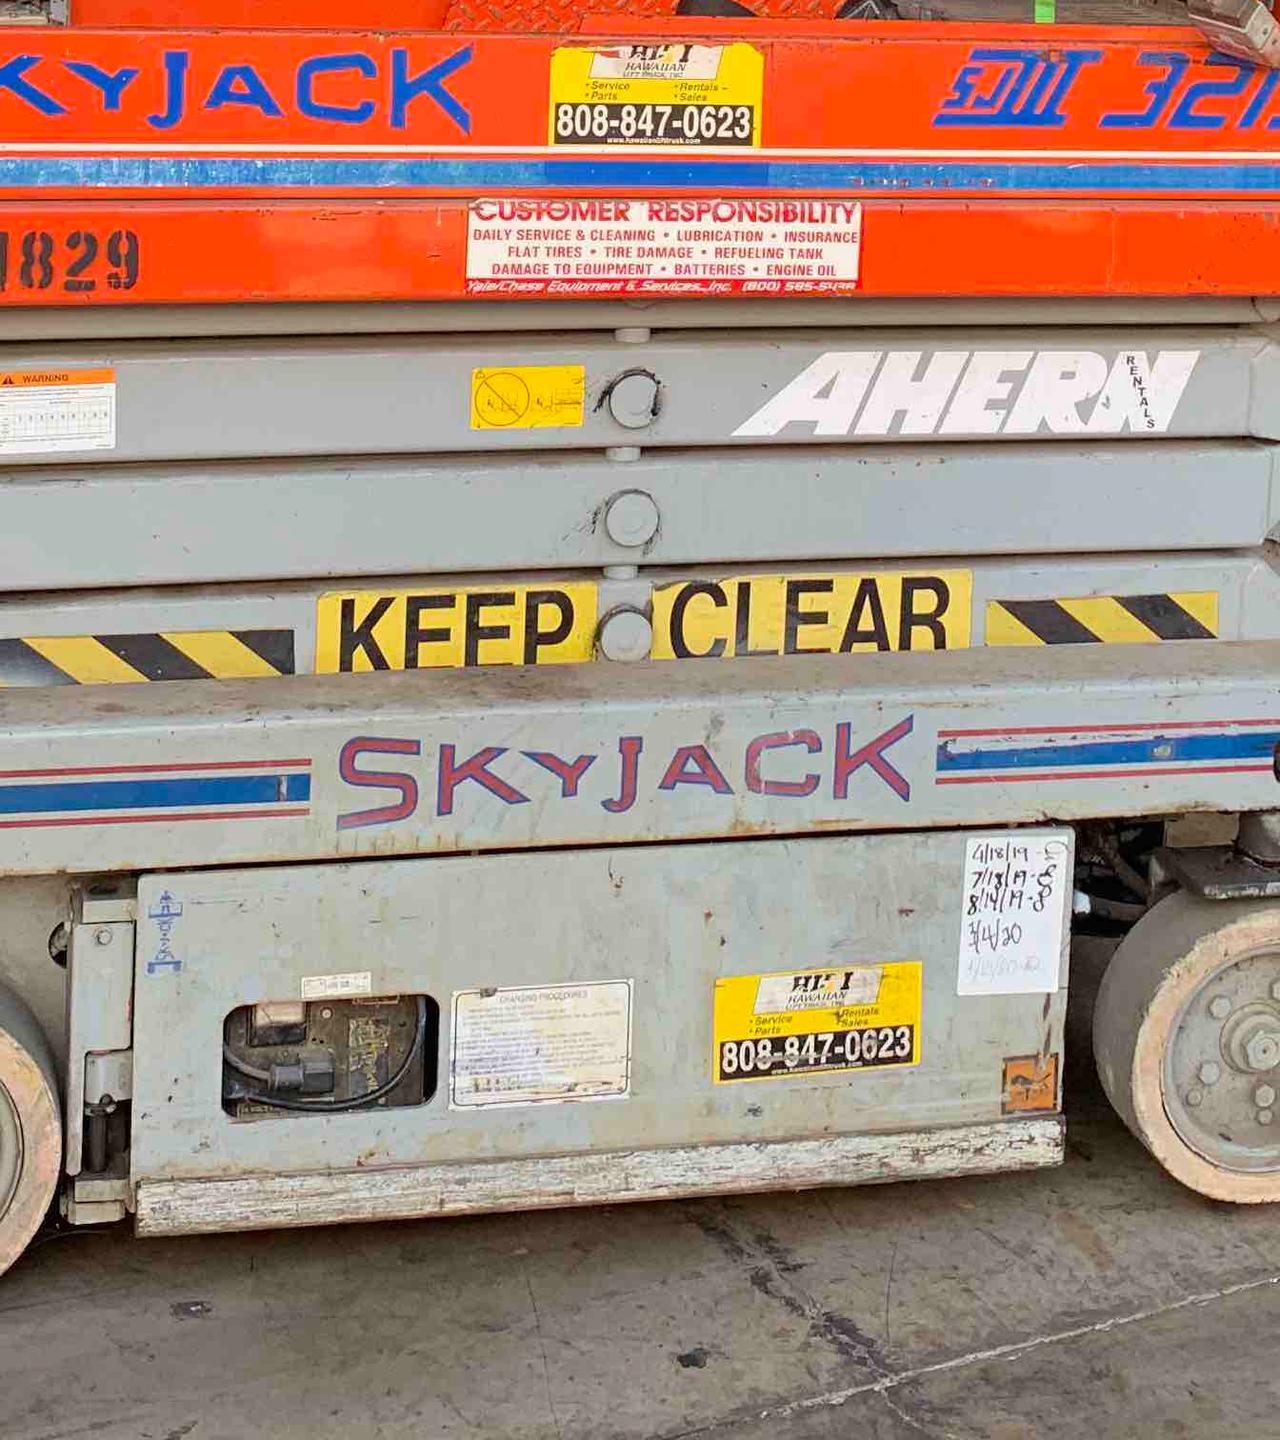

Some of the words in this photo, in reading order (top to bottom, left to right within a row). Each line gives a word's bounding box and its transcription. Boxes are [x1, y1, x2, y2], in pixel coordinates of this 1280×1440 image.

[624, 62, 687, 72] HAWAIIAN
[590, 80, 631, 91] Service
[590, 91, 618, 101] Parts
[679, 92, 708, 102] Sales
[556, 103, 751, 139] 808-847-0623
[474, 200, 631, 222] CUSTOMER
[647, 201, 857, 225] RESPONSIBILITY
[473, 229, 512, 241] DAILY
[516, 229, 572, 241] SERVICE
[590, 229, 656, 242] CLEANING
[676, 230, 764, 243] LUBRICATION
[784, 231, 859, 244] INSURANCE
[508, 246, 541, 258] FLAT
[545, 246, 583, 258] TIRES
[604, 246, 633, 258] TIRE
[637, 247, 694, 259] DAMAGE
[714, 247, 785, 260] REFUELING
[789, 248, 824, 260] TANK
[492, 263, 549, 275] DAMAGE
[554, 263, 571, 275] TO
[575, 263, 653, 276] EQUIPMENT
[674, 264, 746, 276] BATTERIES
[766, 264, 814, 277] ENGINE
[817, 264, 838, 277] OIL
[23, 374, 70, 384] WARNING
[731, 350, 1202, 438] AHERN
[1125, 354, 1156, 429] RENTALS
[338, 589, 576, 674] KEEP
[670, 575, 948, 658] CLEAR
[335, 712, 915, 831] SKYJACK
[754, 1014, 793, 1025] Service
[754, 1026, 781, 1035] Parts
[722, 1026, 911, 1074] 808-847-0623
